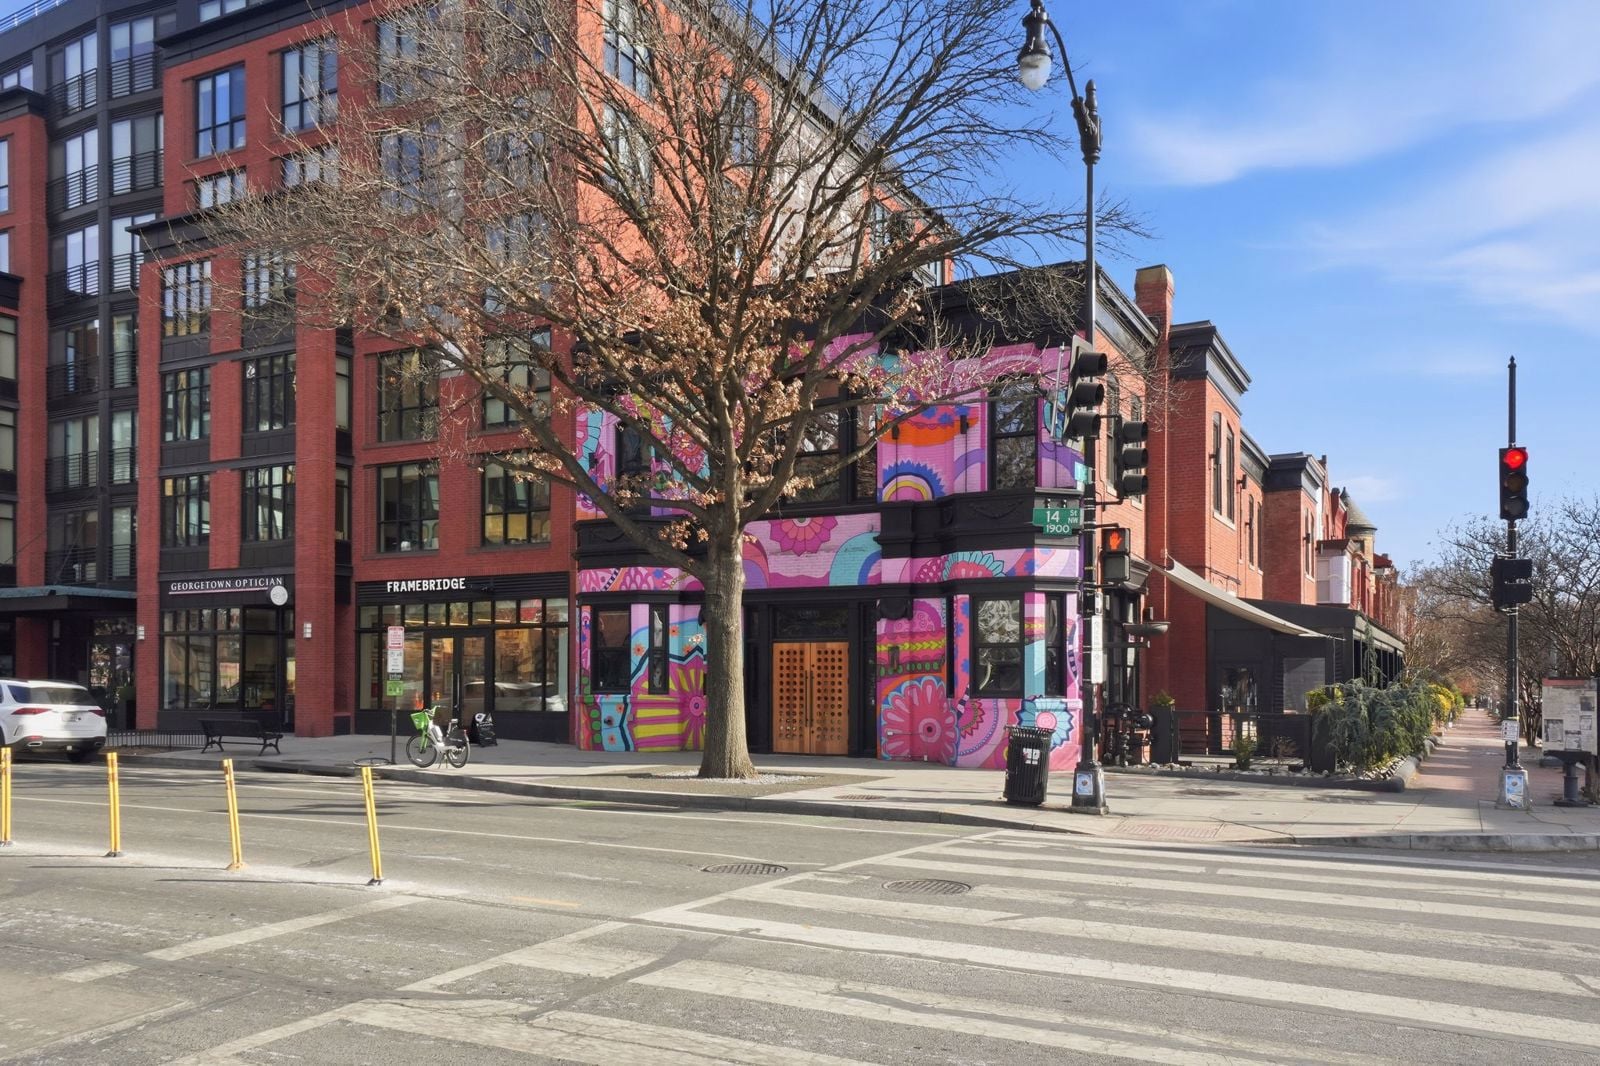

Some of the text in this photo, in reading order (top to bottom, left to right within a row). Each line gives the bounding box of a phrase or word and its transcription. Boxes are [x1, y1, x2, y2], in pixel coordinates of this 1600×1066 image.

[1046, 510, 1060, 523] 14
[1046, 524, 1070, 533] 1900
[170, 577, 283, 591] GEORGETOWN OPTICIAN
[386, 577, 466, 593] FRAMEBRIDGE
